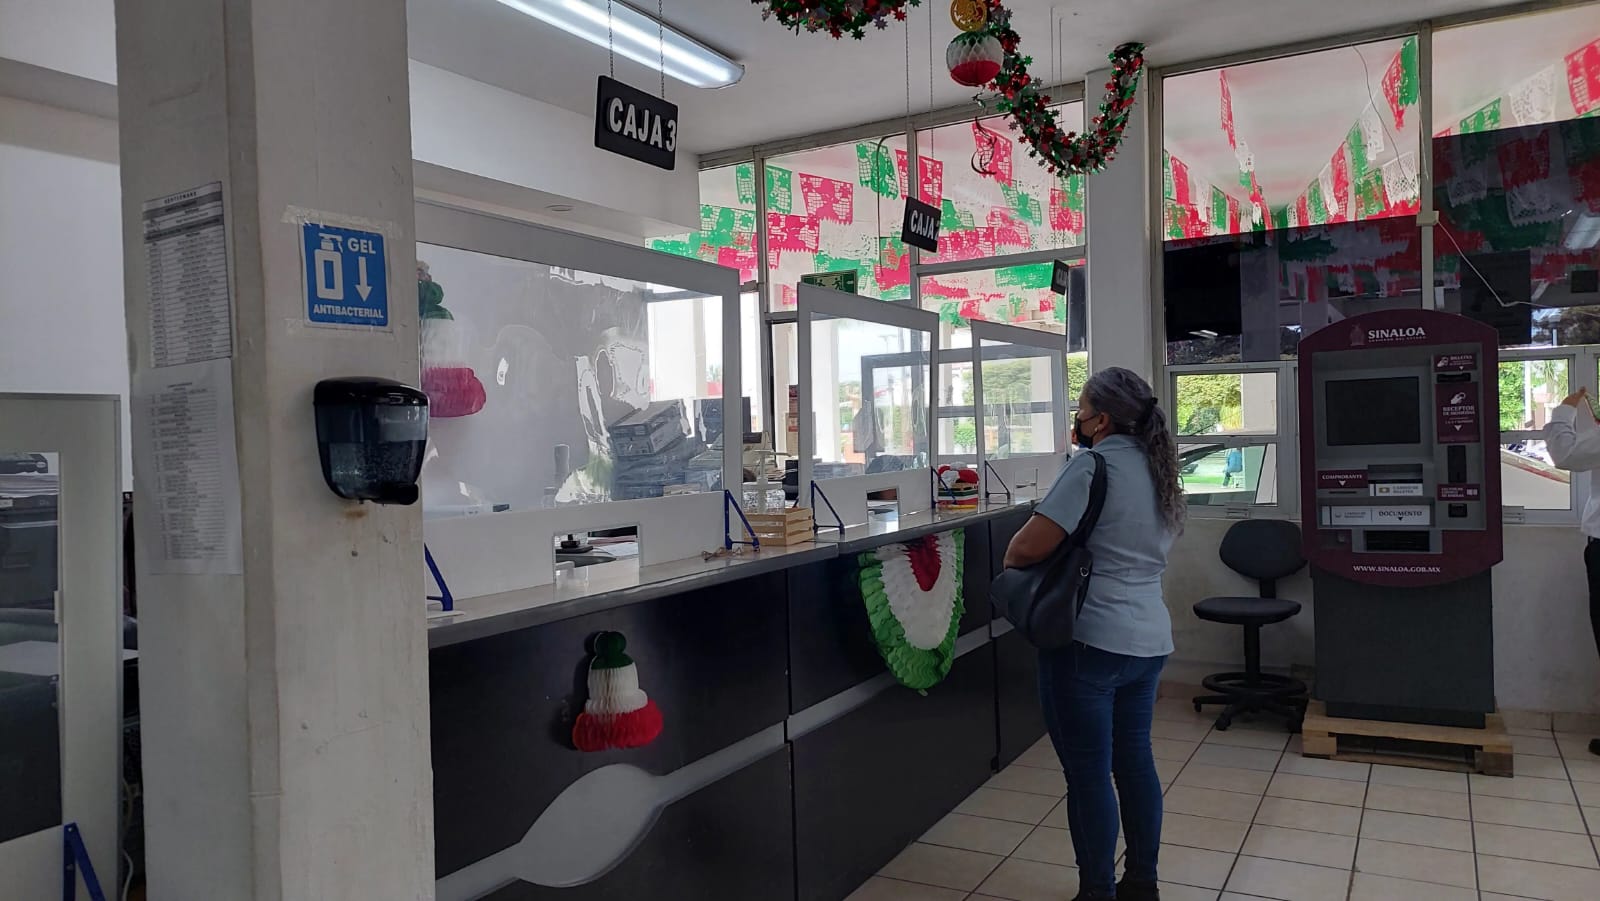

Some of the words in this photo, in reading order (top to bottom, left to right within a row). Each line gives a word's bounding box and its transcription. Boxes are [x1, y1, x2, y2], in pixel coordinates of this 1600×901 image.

[609, 97, 663, 149] CAJA
[666, 119, 677, 152] 3
[910, 209, 935, 240] CAJA
[347, 237, 376, 255] GEL
[313, 303, 385, 319] ANTIBACTERIAL
[1368, 326, 1426, 339] SINALOA
[1352, 565, 1441, 573] WWW.SINALOA.GOB.MX
